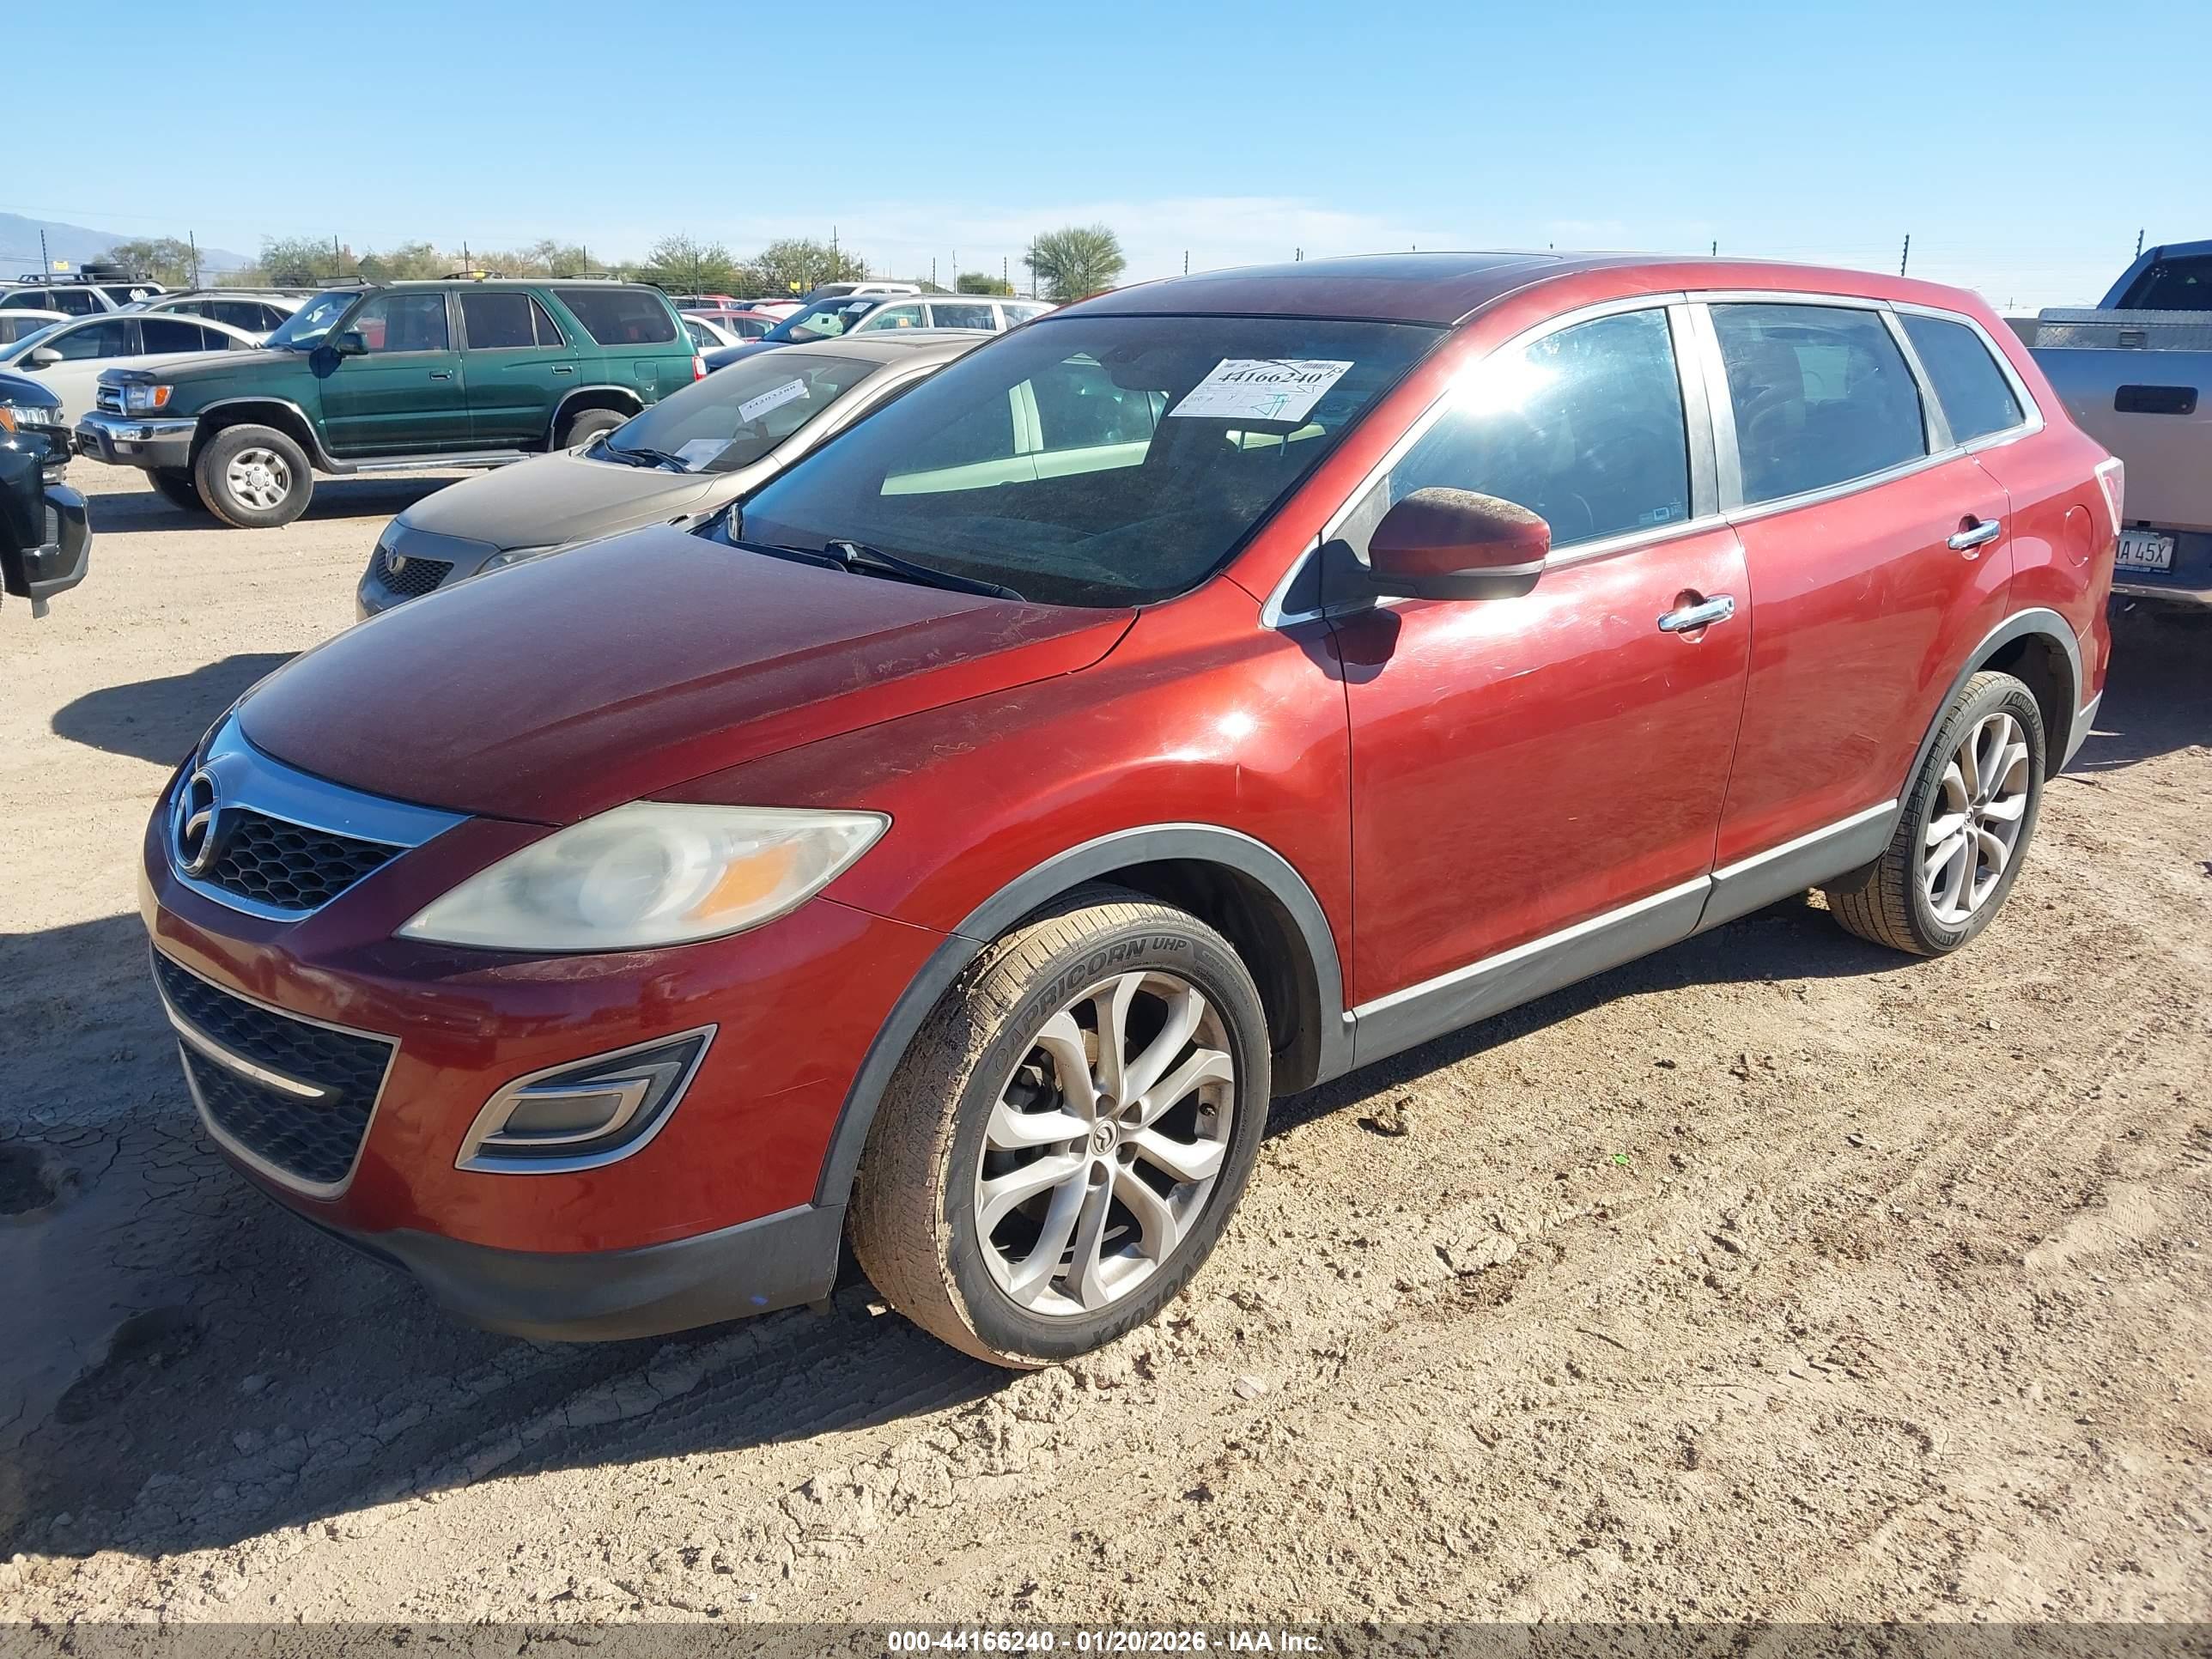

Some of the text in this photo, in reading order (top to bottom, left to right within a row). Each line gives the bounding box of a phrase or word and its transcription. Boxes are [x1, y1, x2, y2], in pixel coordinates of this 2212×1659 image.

[1218, 371, 1323, 384] 44166240
[2136, 542, 2166, 563] 45X
[994, 938, 1146, 1073] CAPRICORN
[1152, 937, 1188, 952] UHP
